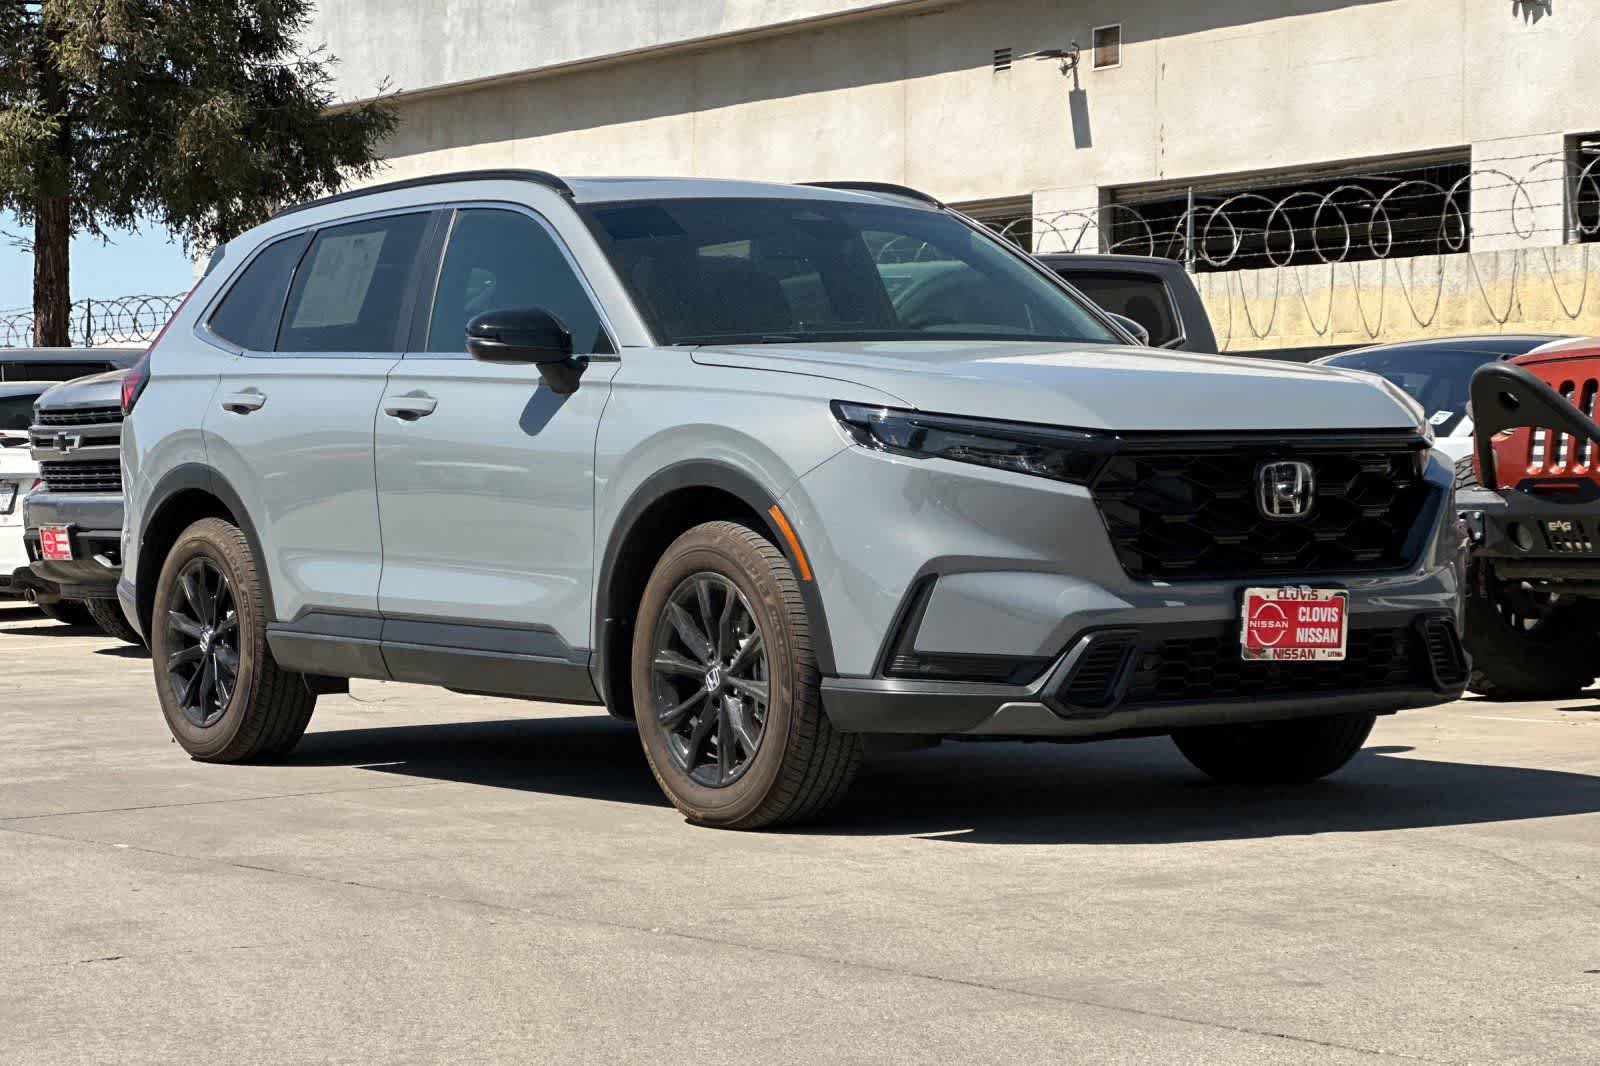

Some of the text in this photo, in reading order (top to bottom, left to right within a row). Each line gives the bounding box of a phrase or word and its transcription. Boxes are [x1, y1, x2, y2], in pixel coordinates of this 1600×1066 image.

[1297, 606, 1339, 623] CLOVIS
[1249, 620, 1289, 628] NISSAN
[1296, 627, 1338, 643] NISSAN
[1272, 649, 1316, 659] NISSAN
